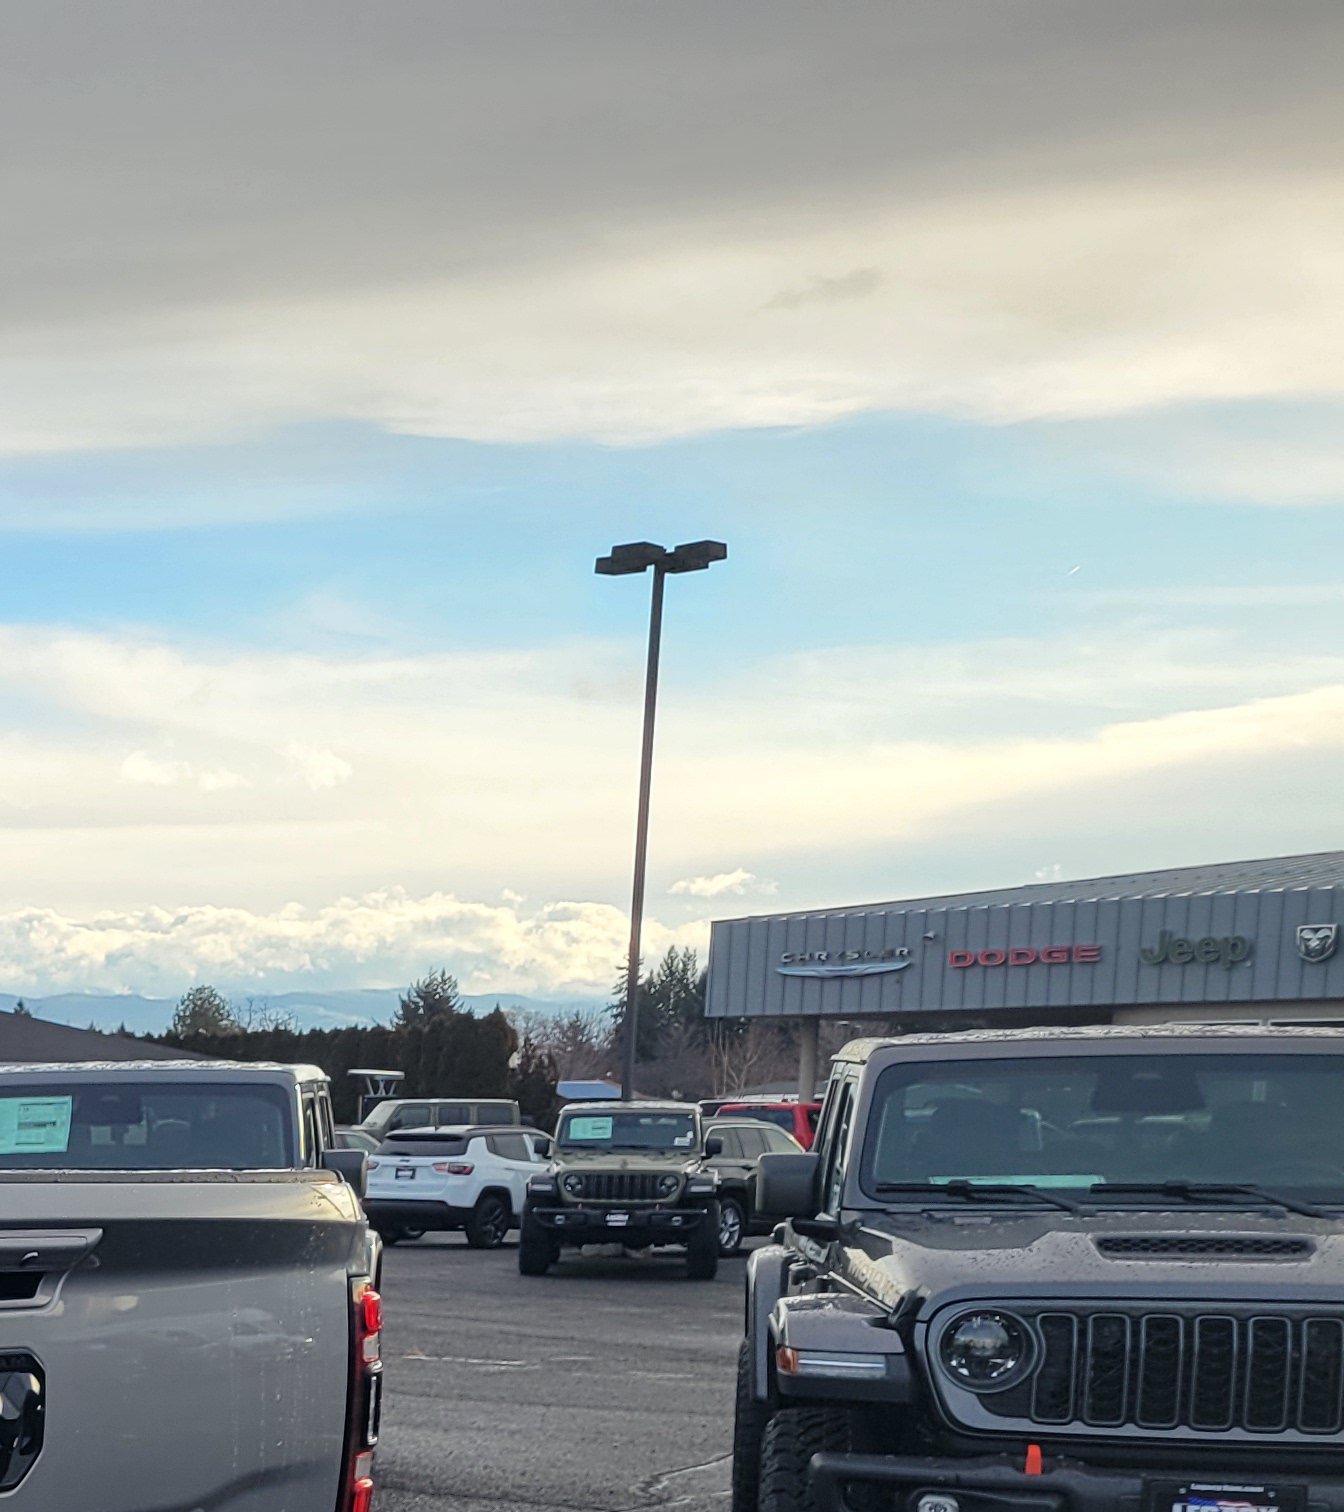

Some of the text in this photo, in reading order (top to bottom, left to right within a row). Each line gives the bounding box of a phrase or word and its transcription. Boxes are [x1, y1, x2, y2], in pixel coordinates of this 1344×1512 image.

[779, 946, 913, 964] CHRYSLER
[947, 943, 1103, 969] DODGE
[1138, 928, 1250, 969] Jeep
